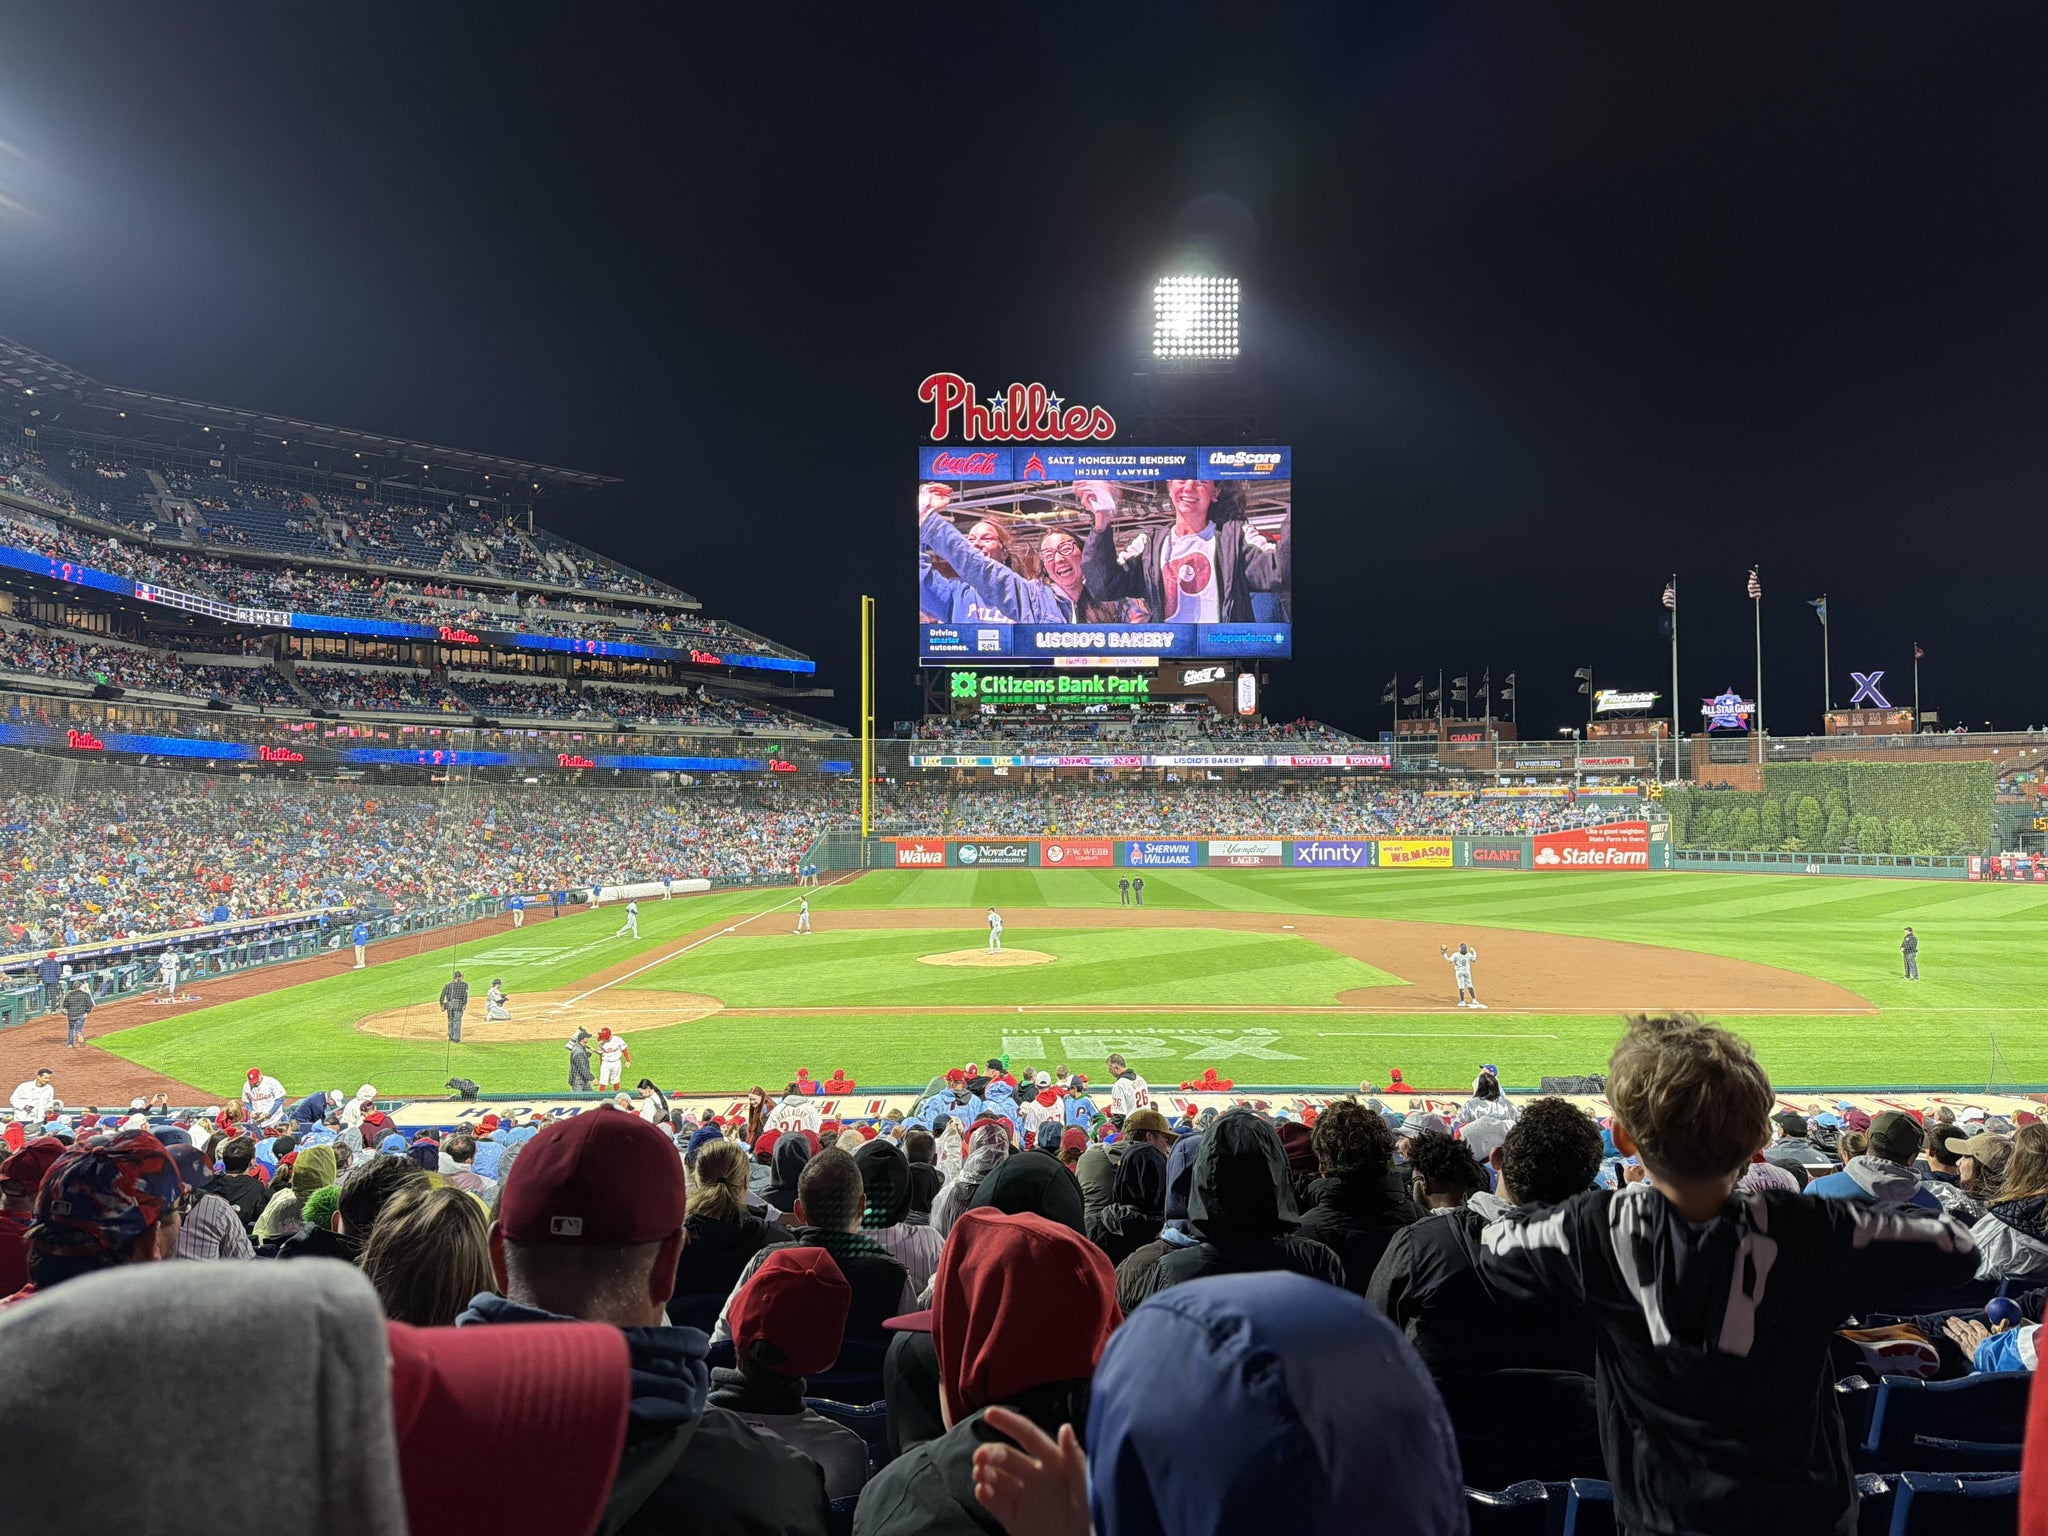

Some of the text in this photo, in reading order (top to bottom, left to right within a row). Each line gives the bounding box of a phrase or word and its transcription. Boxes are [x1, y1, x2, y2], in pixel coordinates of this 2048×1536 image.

[918, 372, 1116, 440] Phillies
[1048, 456, 1187, 465] SALTZ MONGELUZZI BENDESKY
[1210, 452, 1281, 464] theScore
[439, 626, 480, 644] Phillies
[930, 629, 958, 637] Driving
[1036, 632, 1175, 648] LISCIO'S BAKERY
[1207, 633, 1272, 644] Independence
[690, 650, 721, 665] Phillies
[981, 674, 1149, 694] Citizens Bank Park
[1850, 671, 1891, 709] X
[1701, 703, 1756, 715] ALL STAR GAME
[67, 729, 104, 750] Phillies
[1450, 733, 1482, 742] GIANT
[259, 746, 304, 762] Phillies
[558, 753, 594, 768] Phillies
[1294, 757, 1384, 765] TOYOTA TOYOTA
[768, 759, 798, 773] Phillies
[921, 757, 1013, 766] UKG UKG UKG
[978, 845, 1027, 857] NovaCare
[1083, 848, 1109, 856] WEBB
[1145, 843, 1190, 854] SHERWIN
[1298, 842, 1363, 864] xfinity
[1473, 849, 1521, 862] GIANT
[900, 850, 943, 864] Wawa
[1230, 856, 1260, 864] LAGER
[1561, 847, 1647, 865] State Farm
[1805, 864, 1820, 874] 401
[1002, 1027, 1234, 1036] Independence
[1001, 1035, 1310, 1060] IBX
[1135, 1089, 1149, 1109] 26
[776, 1106, 808, 1121] HALLADAY
